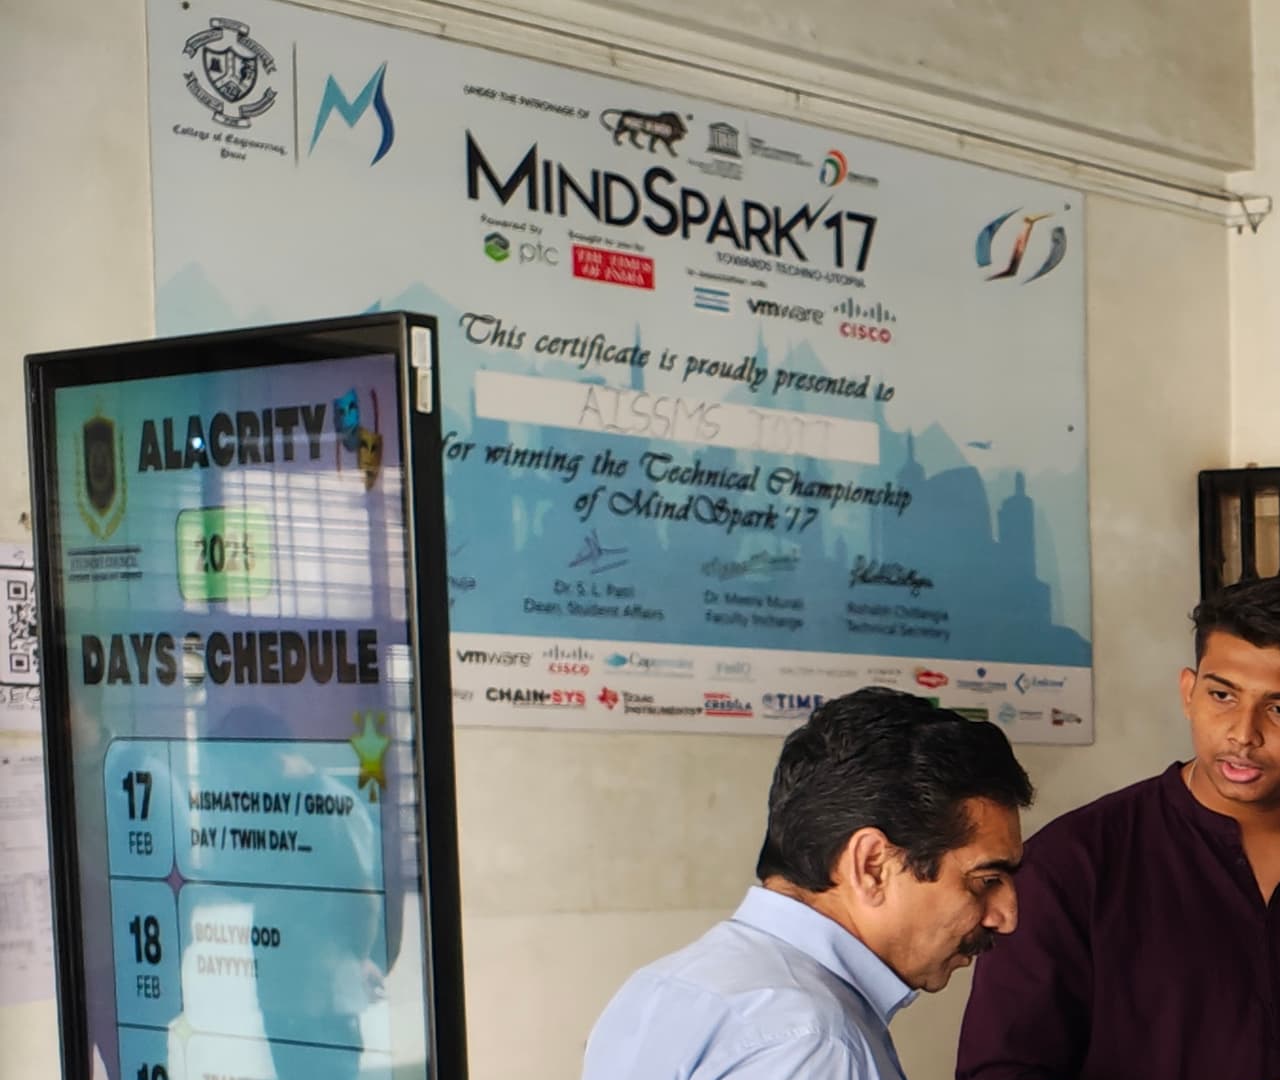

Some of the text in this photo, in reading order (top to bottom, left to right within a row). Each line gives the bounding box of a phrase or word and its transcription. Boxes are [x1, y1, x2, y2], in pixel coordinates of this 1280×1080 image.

[519, 240, 559, 267] ptc
[459, 313, 869, 399] This certificate proudly presented
[138, 403, 327, 473] ALACRITY
[579, 386, 721, 440] AISSMS
[486, 443, 912, 516] winning the Technical Championship
[82, 629, 379, 686] DAYS SCHEDULE
[122, 770, 153, 821] 17
[189, 790, 354, 816] MISMATCH DAY GROUP
[129, 831, 153, 856] FEB
[190, 827, 264, 850] DAY TWIN
[130, 915, 161, 965] 18
[194, 921, 281, 948] BOLLYWOOD
[137, 974, 160, 999] FEB
